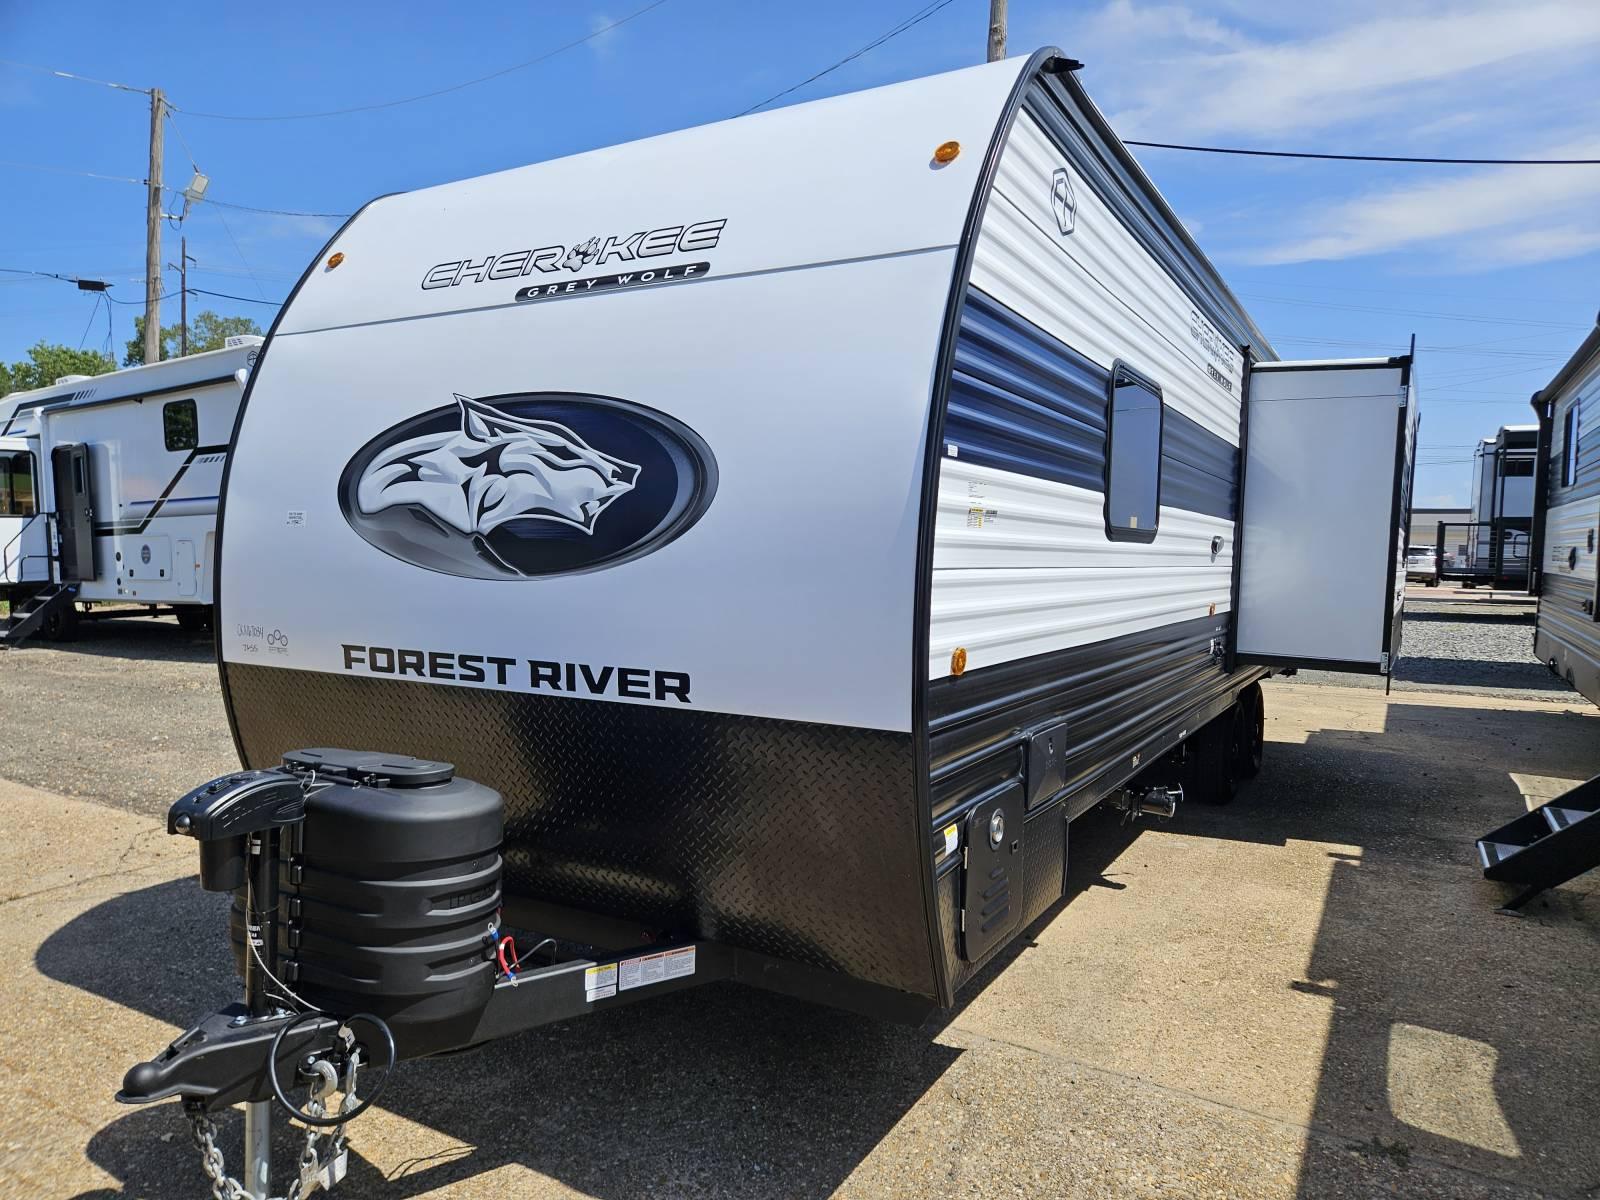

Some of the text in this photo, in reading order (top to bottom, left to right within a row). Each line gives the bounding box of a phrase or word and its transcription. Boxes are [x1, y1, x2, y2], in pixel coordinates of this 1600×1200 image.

[527, 264, 697, 298] GREY WOLF
[341, 643, 693, 703] FOREST RIVER
